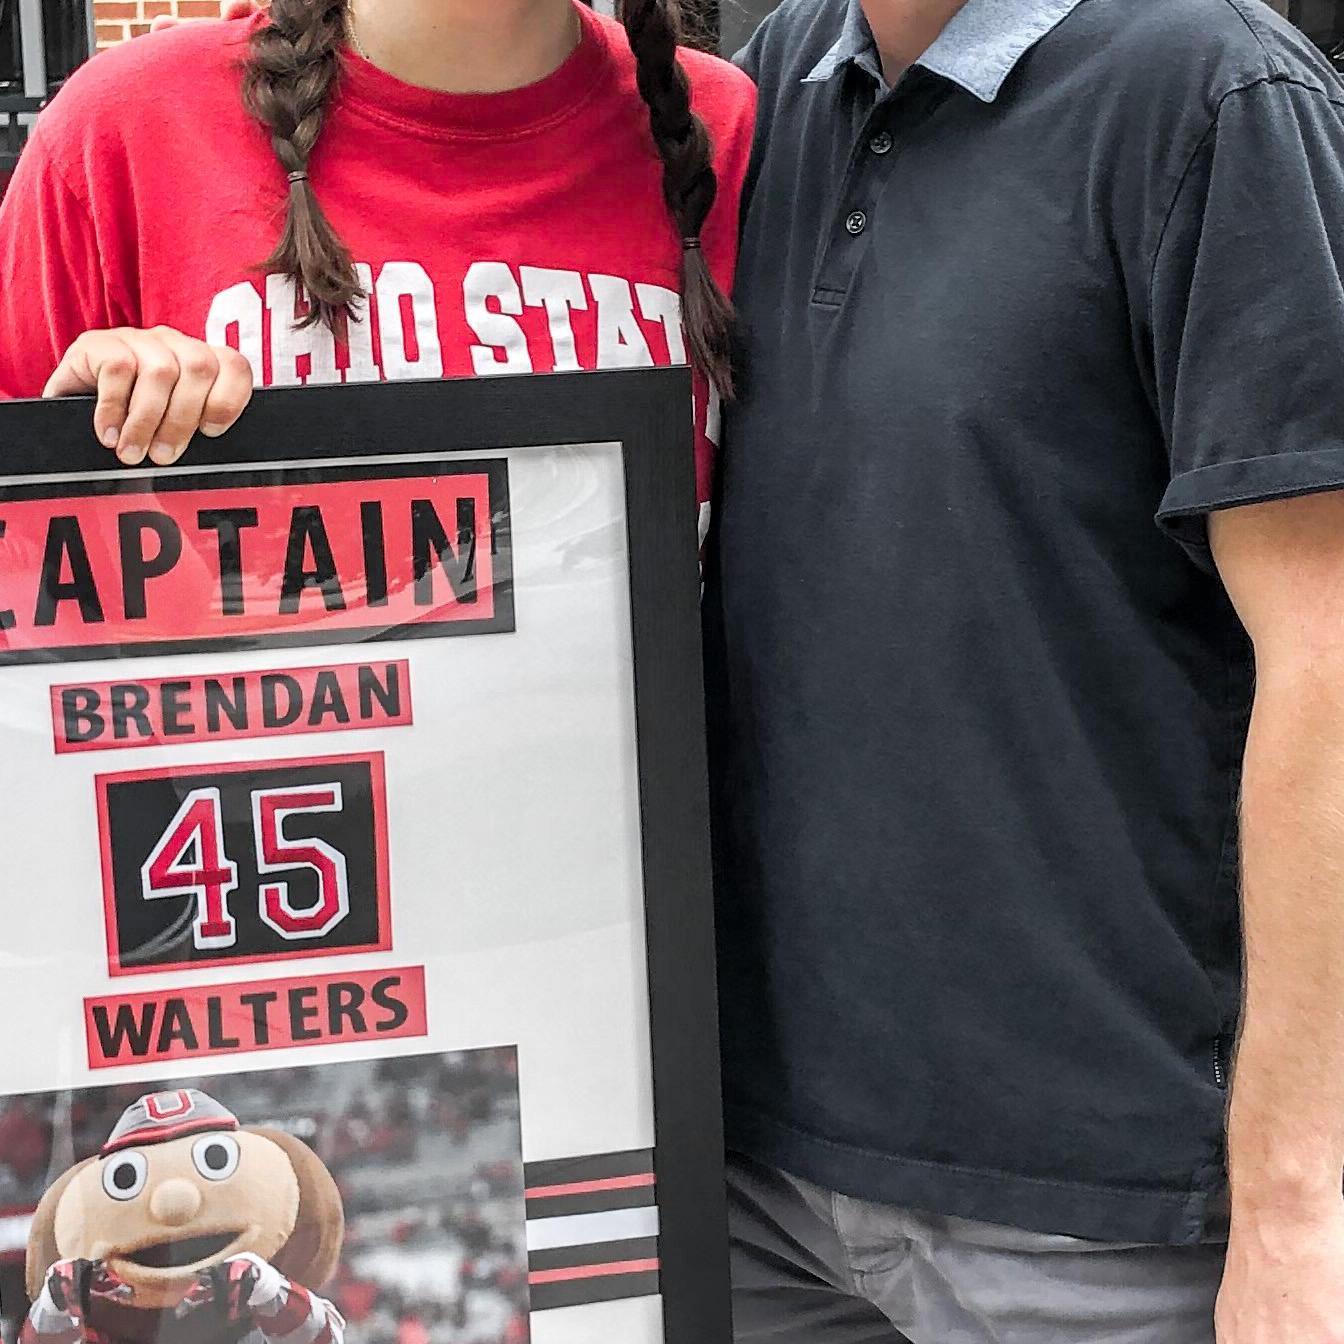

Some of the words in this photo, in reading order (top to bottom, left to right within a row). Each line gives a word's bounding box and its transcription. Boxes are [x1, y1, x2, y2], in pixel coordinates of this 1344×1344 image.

[205, 262, 443, 386] OHIO
[463, 262, 687, 375] STAT
[61, 664, 402, 743] BRENDAN
[141, 783, 349, 950] 45
[93, 976, 409, 1058] WALTERS
